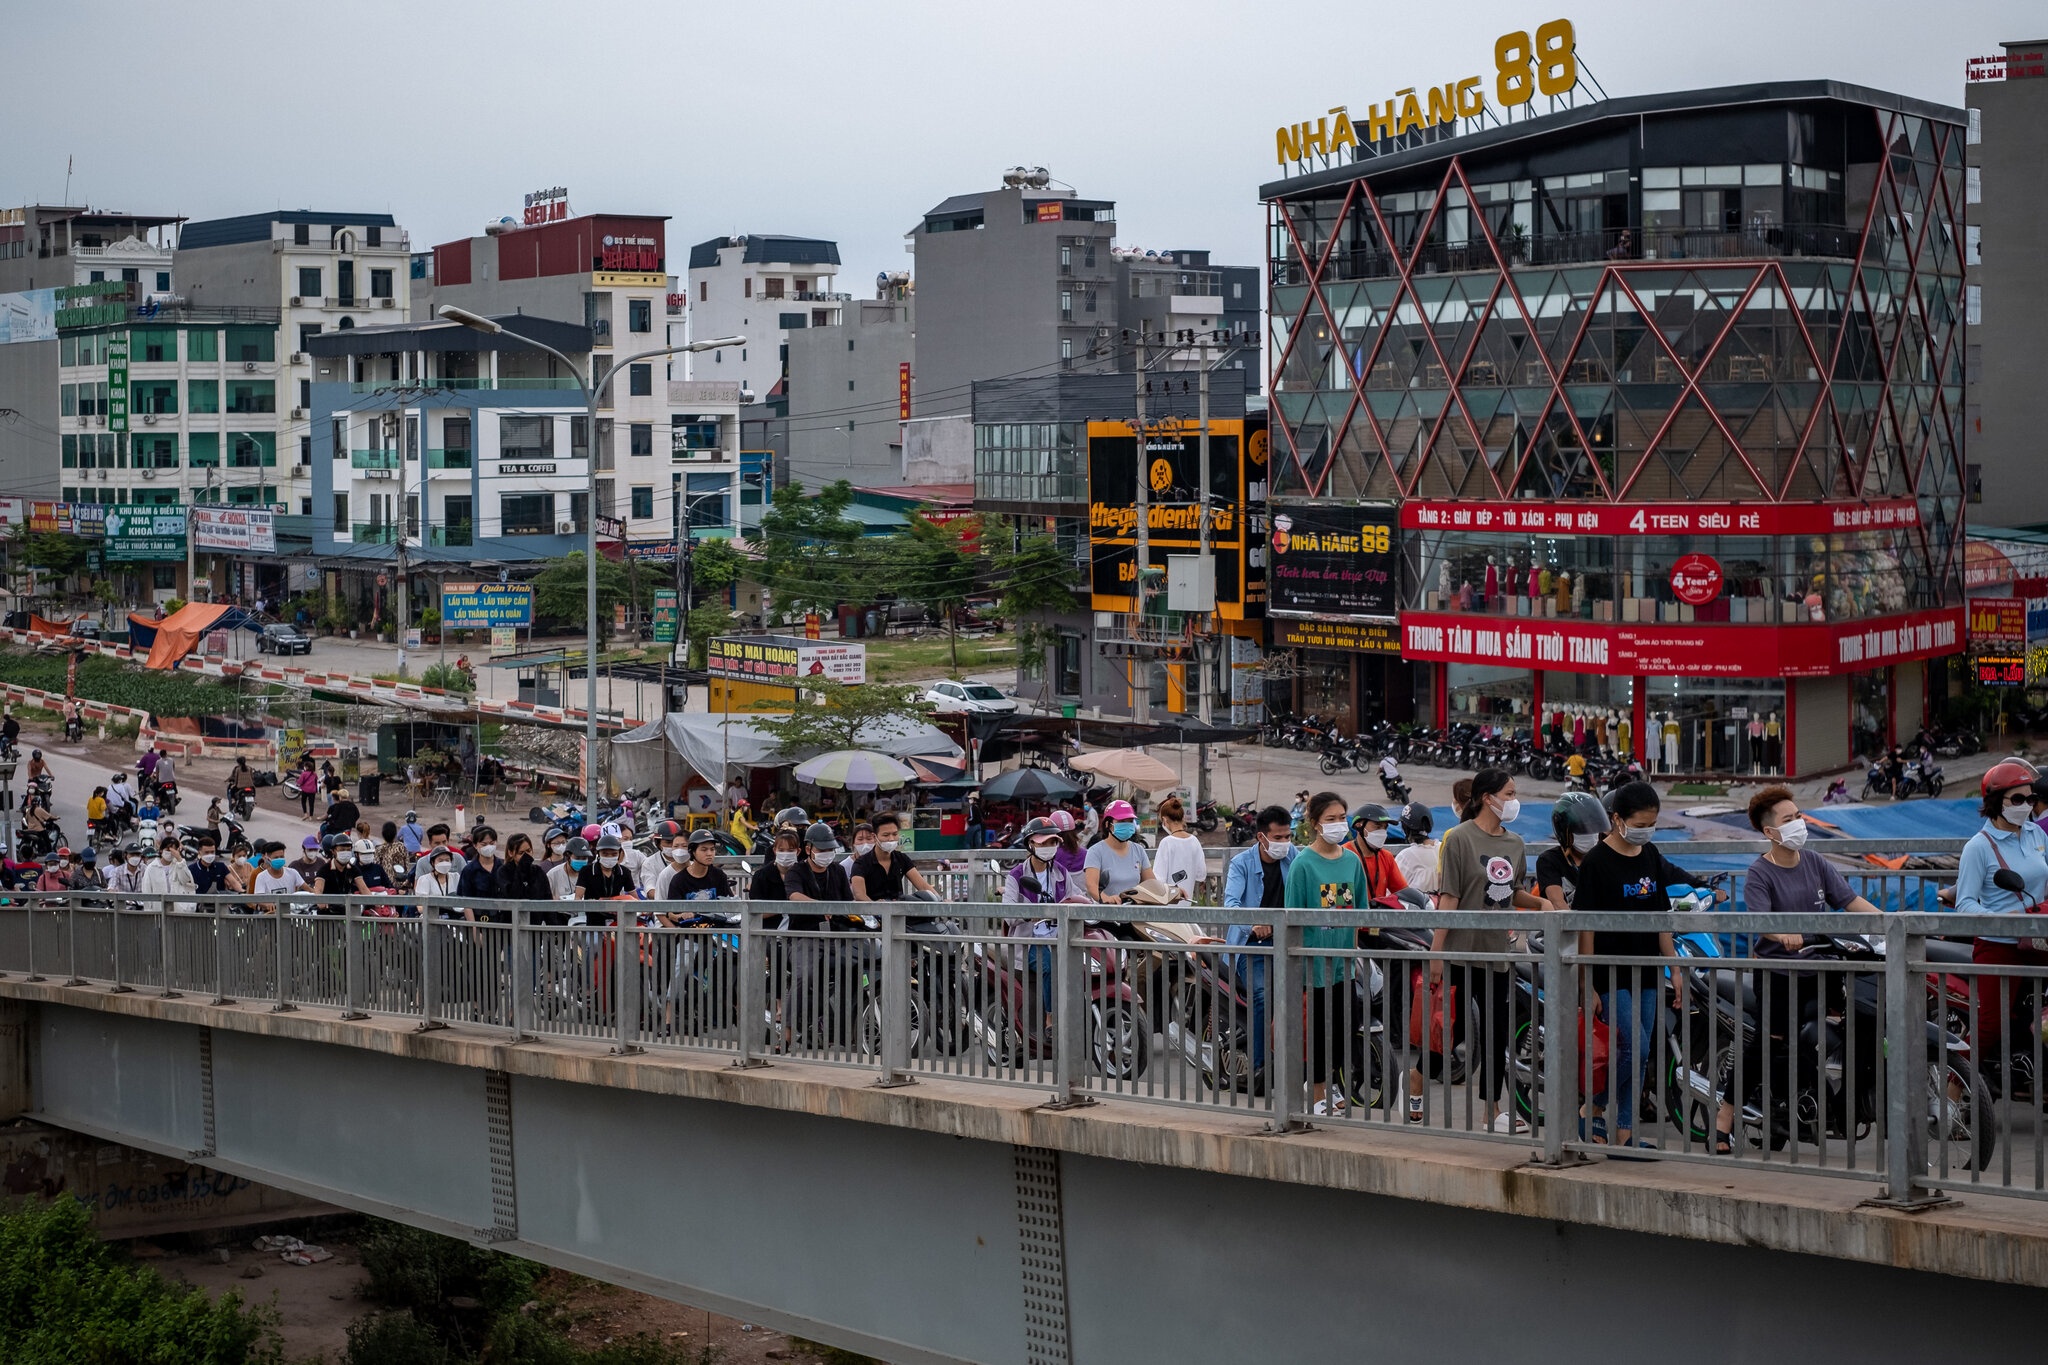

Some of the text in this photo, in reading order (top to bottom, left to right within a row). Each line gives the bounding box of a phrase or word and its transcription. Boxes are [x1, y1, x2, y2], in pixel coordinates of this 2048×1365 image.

[1495, 18, 1576, 107] 88
[111, 387, 125, 399] KHOA
[528, 464, 554, 472] COFFEE
[1249, 478, 1267, 501] BÁ
[119, 507, 132, 515] KHU
[133, 506, 151, 515] KHÁM
[153, 507, 158, 515] &
[228, 513, 246, 525] HONDA
[1503, 509, 1516, 526] TÚI
[1521, 509, 1544, 526] XÁCH
[1555, 513, 1573, 529] PHỤ
[1578, 511, 1598, 529] KIỆN
[128, 527, 153, 535] KHOA
[131, 517, 150, 525] NHA
[1629, 510, 1760, 532] 4 TEEN SIÊU RẺ
[1362, 525, 1390, 553] 88
[1249, 544, 1266, 567] GÓ
[1119, 559, 1138, 581] BÁ
[1302, 567, 1320, 579] hoa
[1364, 569, 1388, 585] Việt
[1673, 572, 1707, 588] 4 Teen
[1972, 608, 1996, 632] LẨU
[1361, 627, 1367, 635] &
[1376, 640, 1381, 649] 4
[1408, 624, 1609, 665] TRUNG TÂM MUA SẮM THỜI TRANG
[1839, 634, 1863, 664] TRUNG
[1865, 629, 1880, 659] TÂM
[1881, 629, 1898, 656] MUA
[1934, 620, 1956, 647] TRANG
[745, 645, 763, 660] MAI
[765, 646, 797, 665] HOÀNG
[709, 656, 724, 668] MUA
[768, 664, 782, 676] NHÀ
